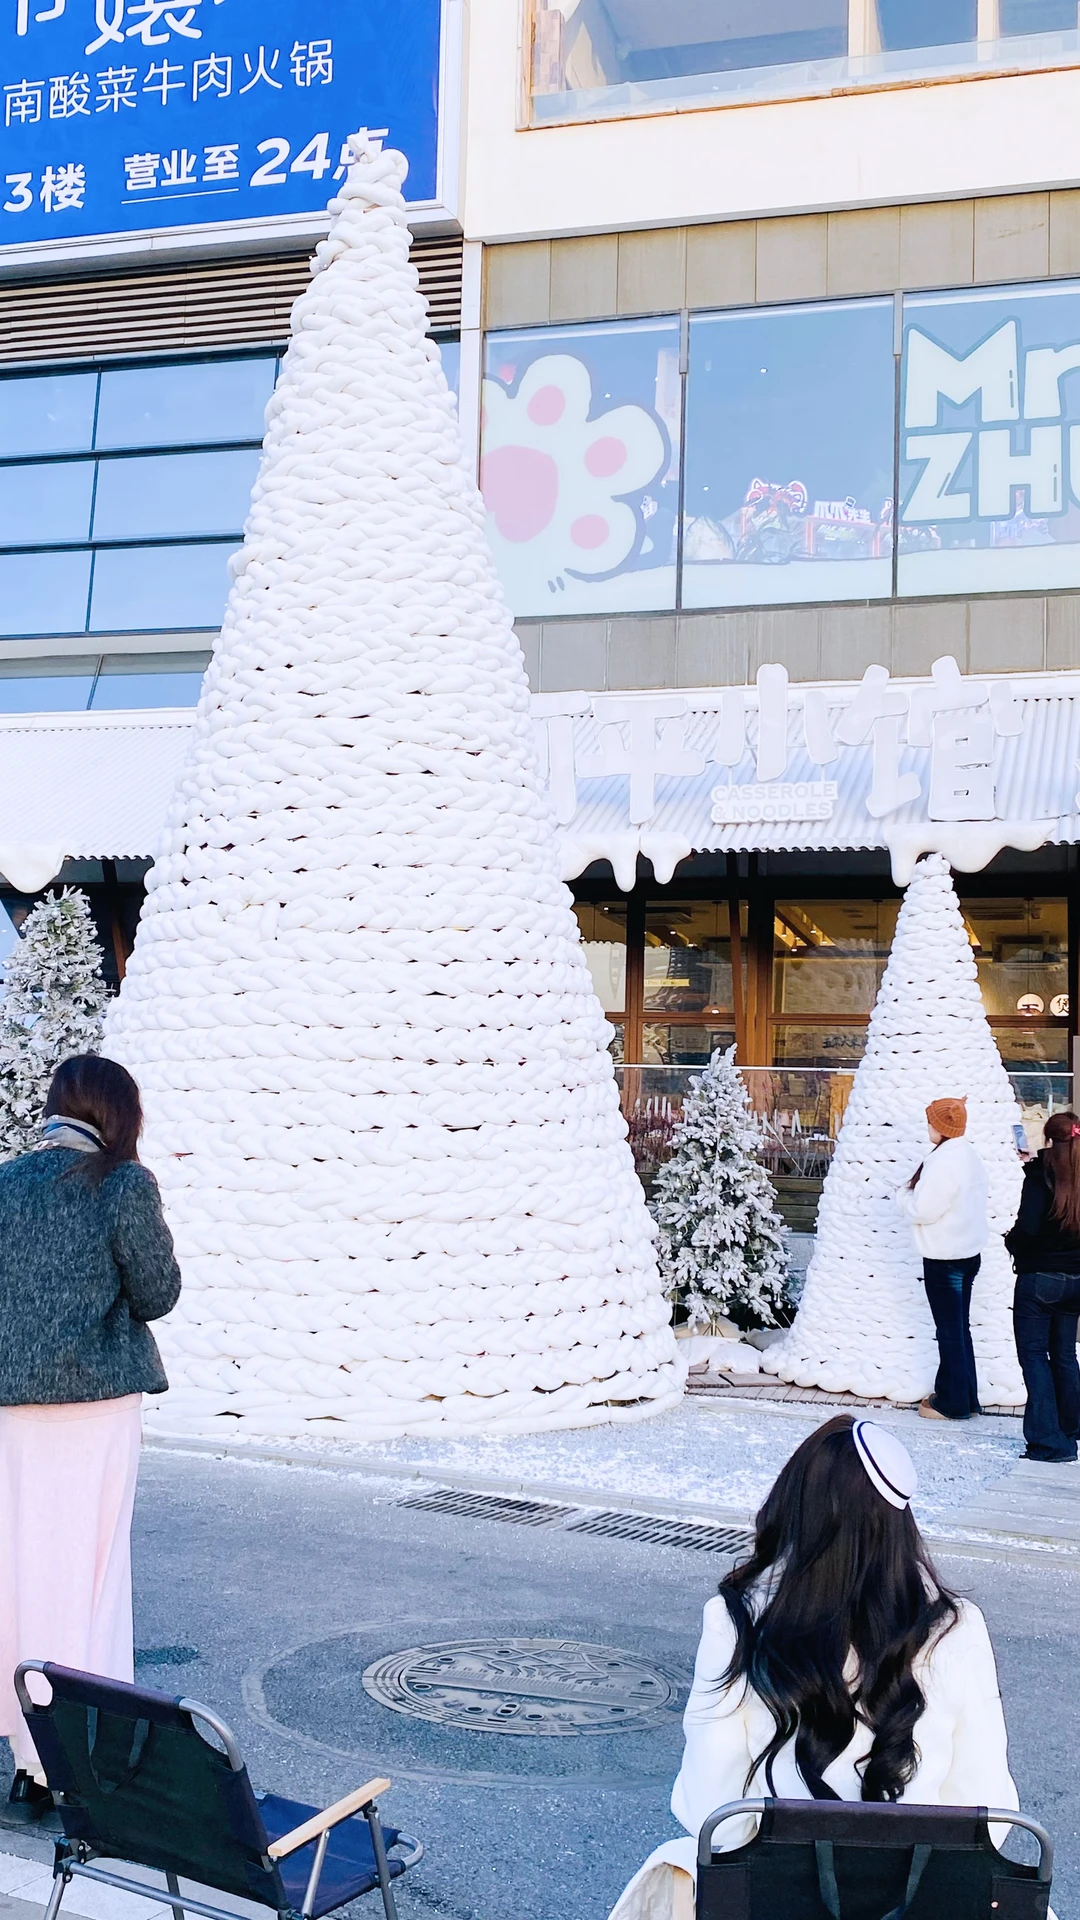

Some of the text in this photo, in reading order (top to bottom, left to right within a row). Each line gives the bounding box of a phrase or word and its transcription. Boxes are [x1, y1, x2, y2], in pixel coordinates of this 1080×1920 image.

[3, 39, 333, 127] 南酸菜牛肉火锅
[3, 162, 87, 214] 3楼
[901, 423, 1080, 523] ZH
[713, 783, 836, 801] CASSEROLE
[713, 802, 831, 820] & NOODLES
